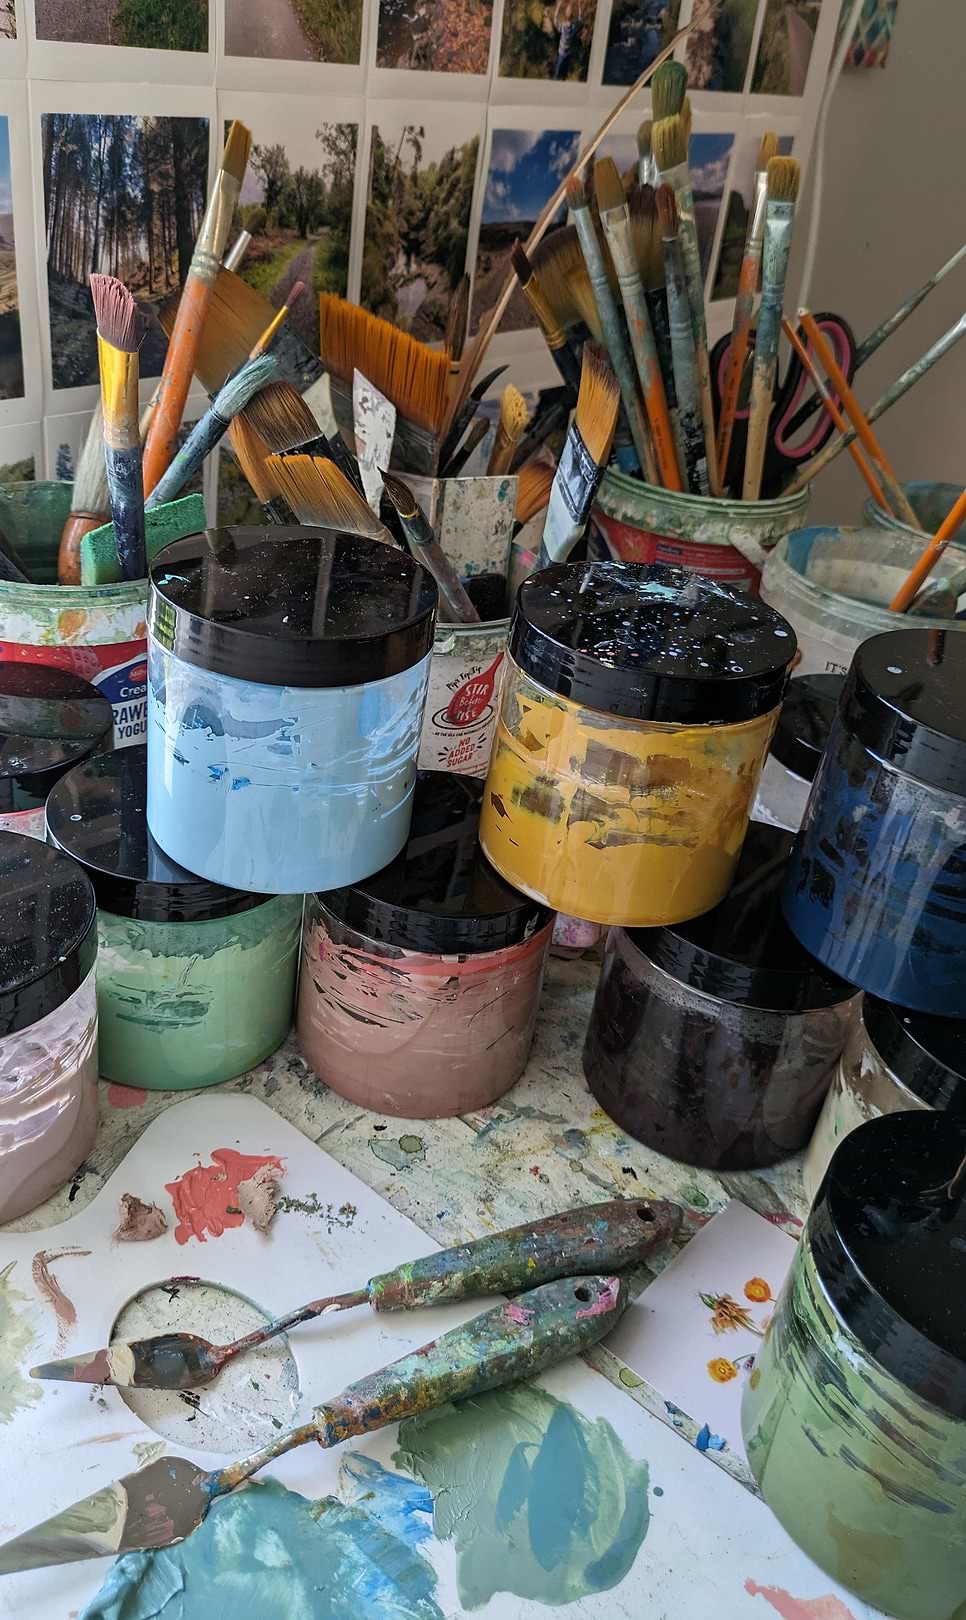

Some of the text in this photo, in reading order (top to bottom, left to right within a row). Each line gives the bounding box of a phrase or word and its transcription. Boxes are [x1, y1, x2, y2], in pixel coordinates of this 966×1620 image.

[825, 661, 847, 676] IT'S
[465, 683, 490, 697] STIR
[456, 708, 478, 721] USE
[459, 737, 471, 748] NO
[448, 743, 476, 759] ADDED
[447, 752, 473, 768] SUGAR
